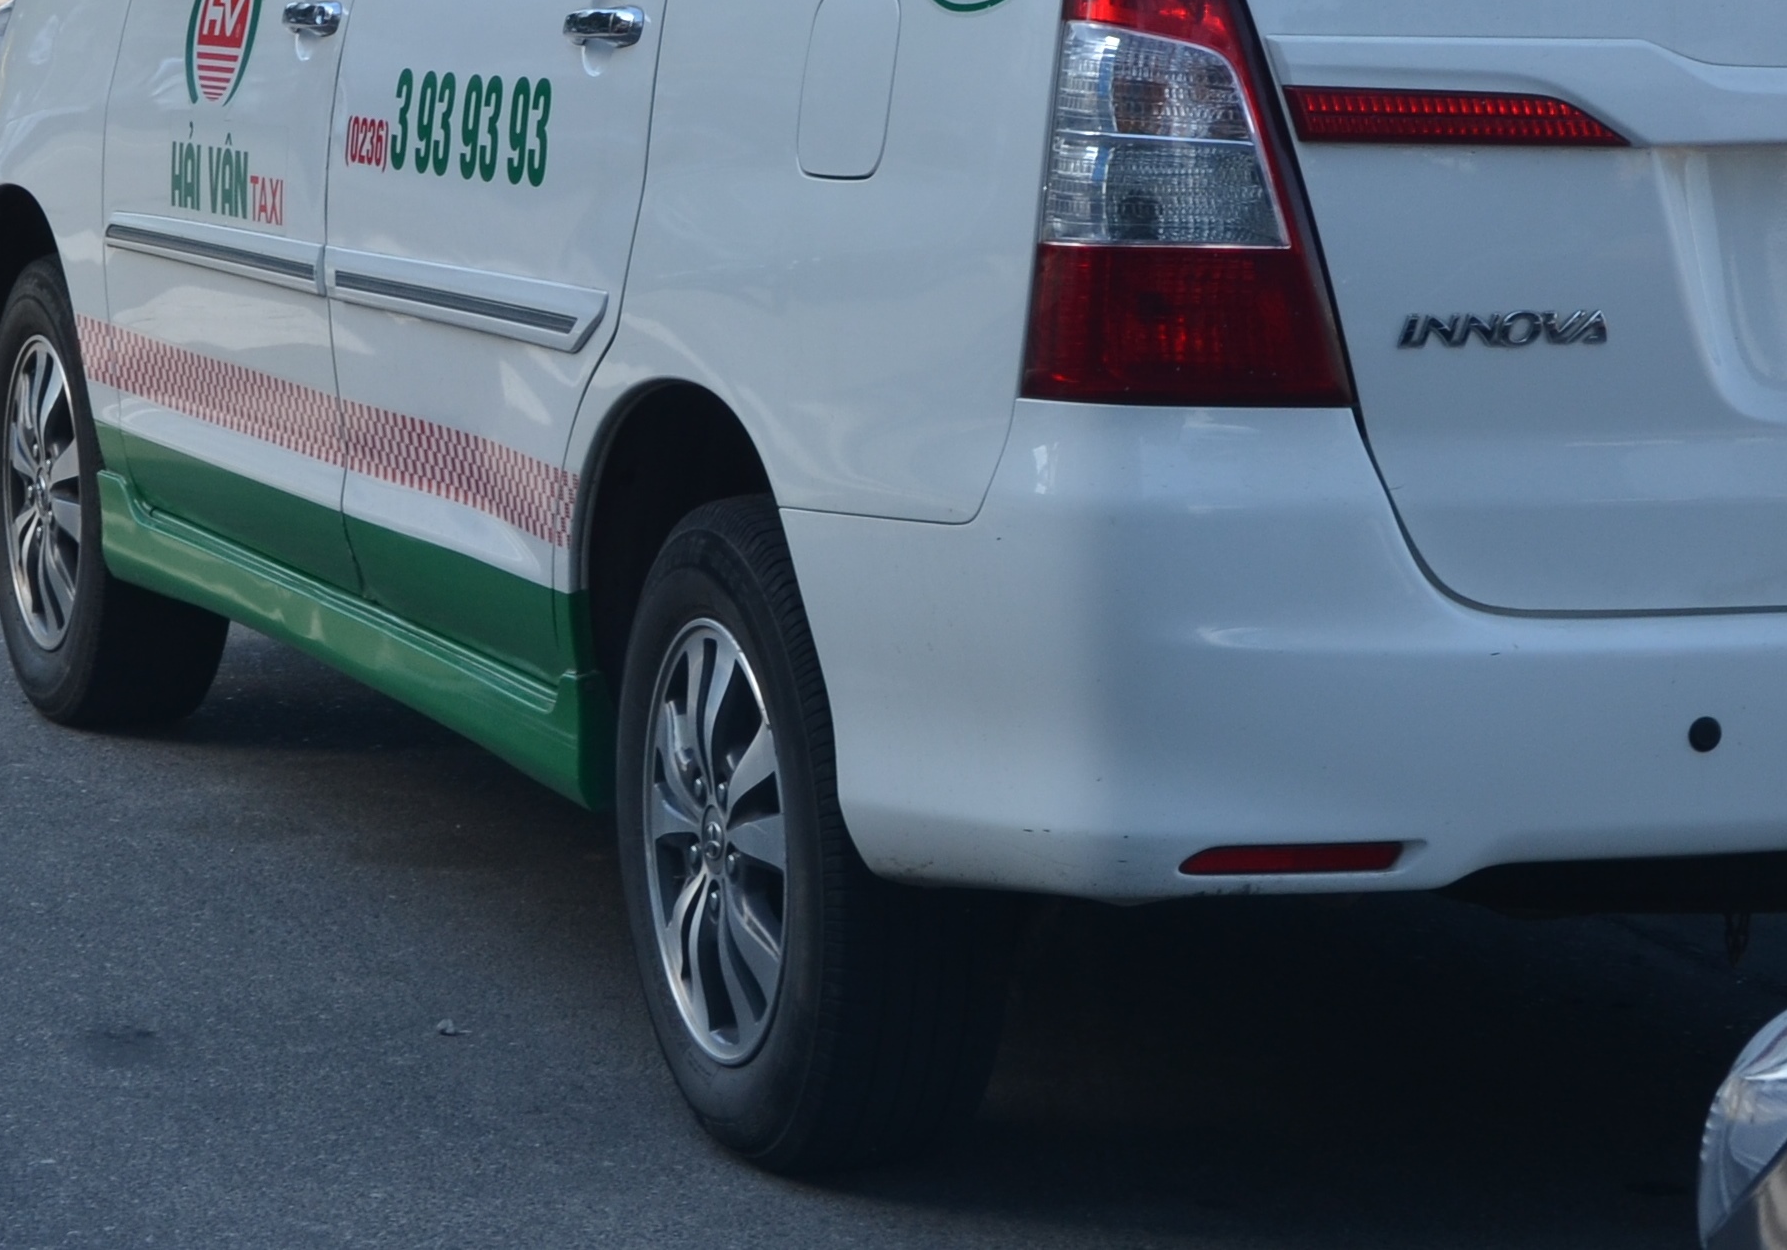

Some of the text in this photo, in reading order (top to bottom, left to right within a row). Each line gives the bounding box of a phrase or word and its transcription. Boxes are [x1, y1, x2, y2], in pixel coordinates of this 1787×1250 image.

[171, 120, 284, 226] HẢI VÂN TAXI
[345, 114, 390, 174] (0236)
[1396, 309, 1608, 350] INNOVA
